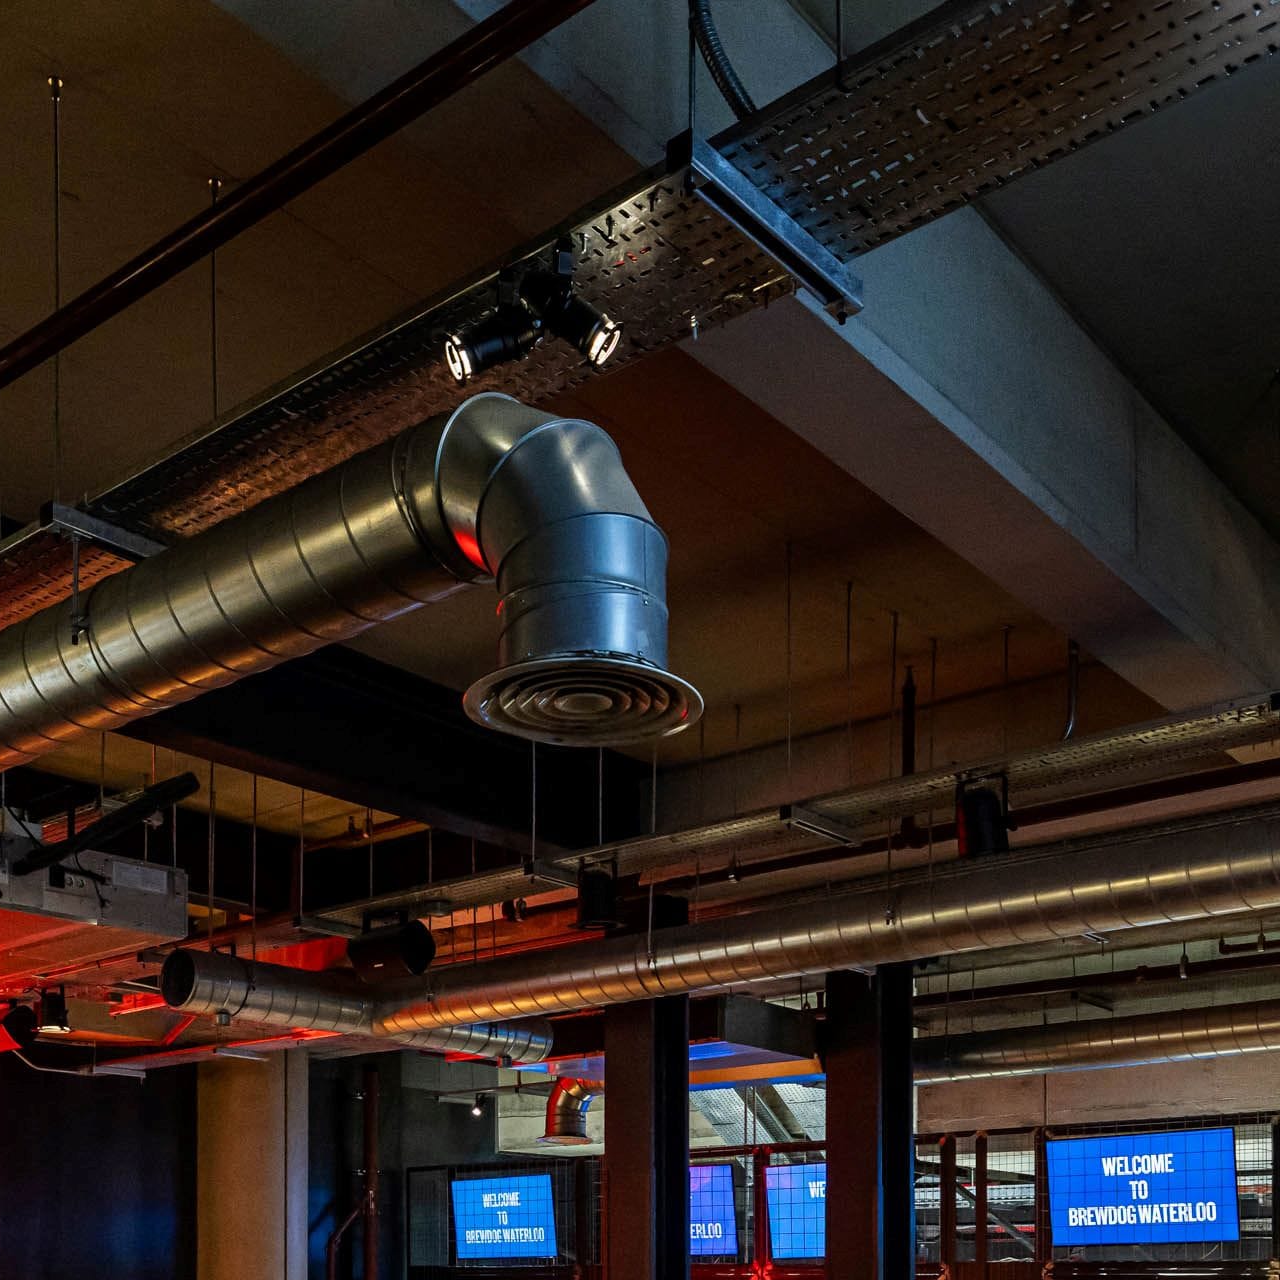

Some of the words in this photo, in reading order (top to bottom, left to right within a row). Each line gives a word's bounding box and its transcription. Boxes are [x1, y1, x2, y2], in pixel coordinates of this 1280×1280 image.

[1102, 1153, 1174, 1176] WELCOME
[1129, 1180, 1149, 1200] TO
[482, 1192, 521, 1208] WELCOME
[497, 1211, 507, 1225] TO
[1068, 1206, 1136, 1227] BREWDOG
[1137, 1201, 1217, 1225] WATERLOO
[465, 1230, 503, 1244] BREWDOG
[503, 1227, 545, 1243] WATERLOO
